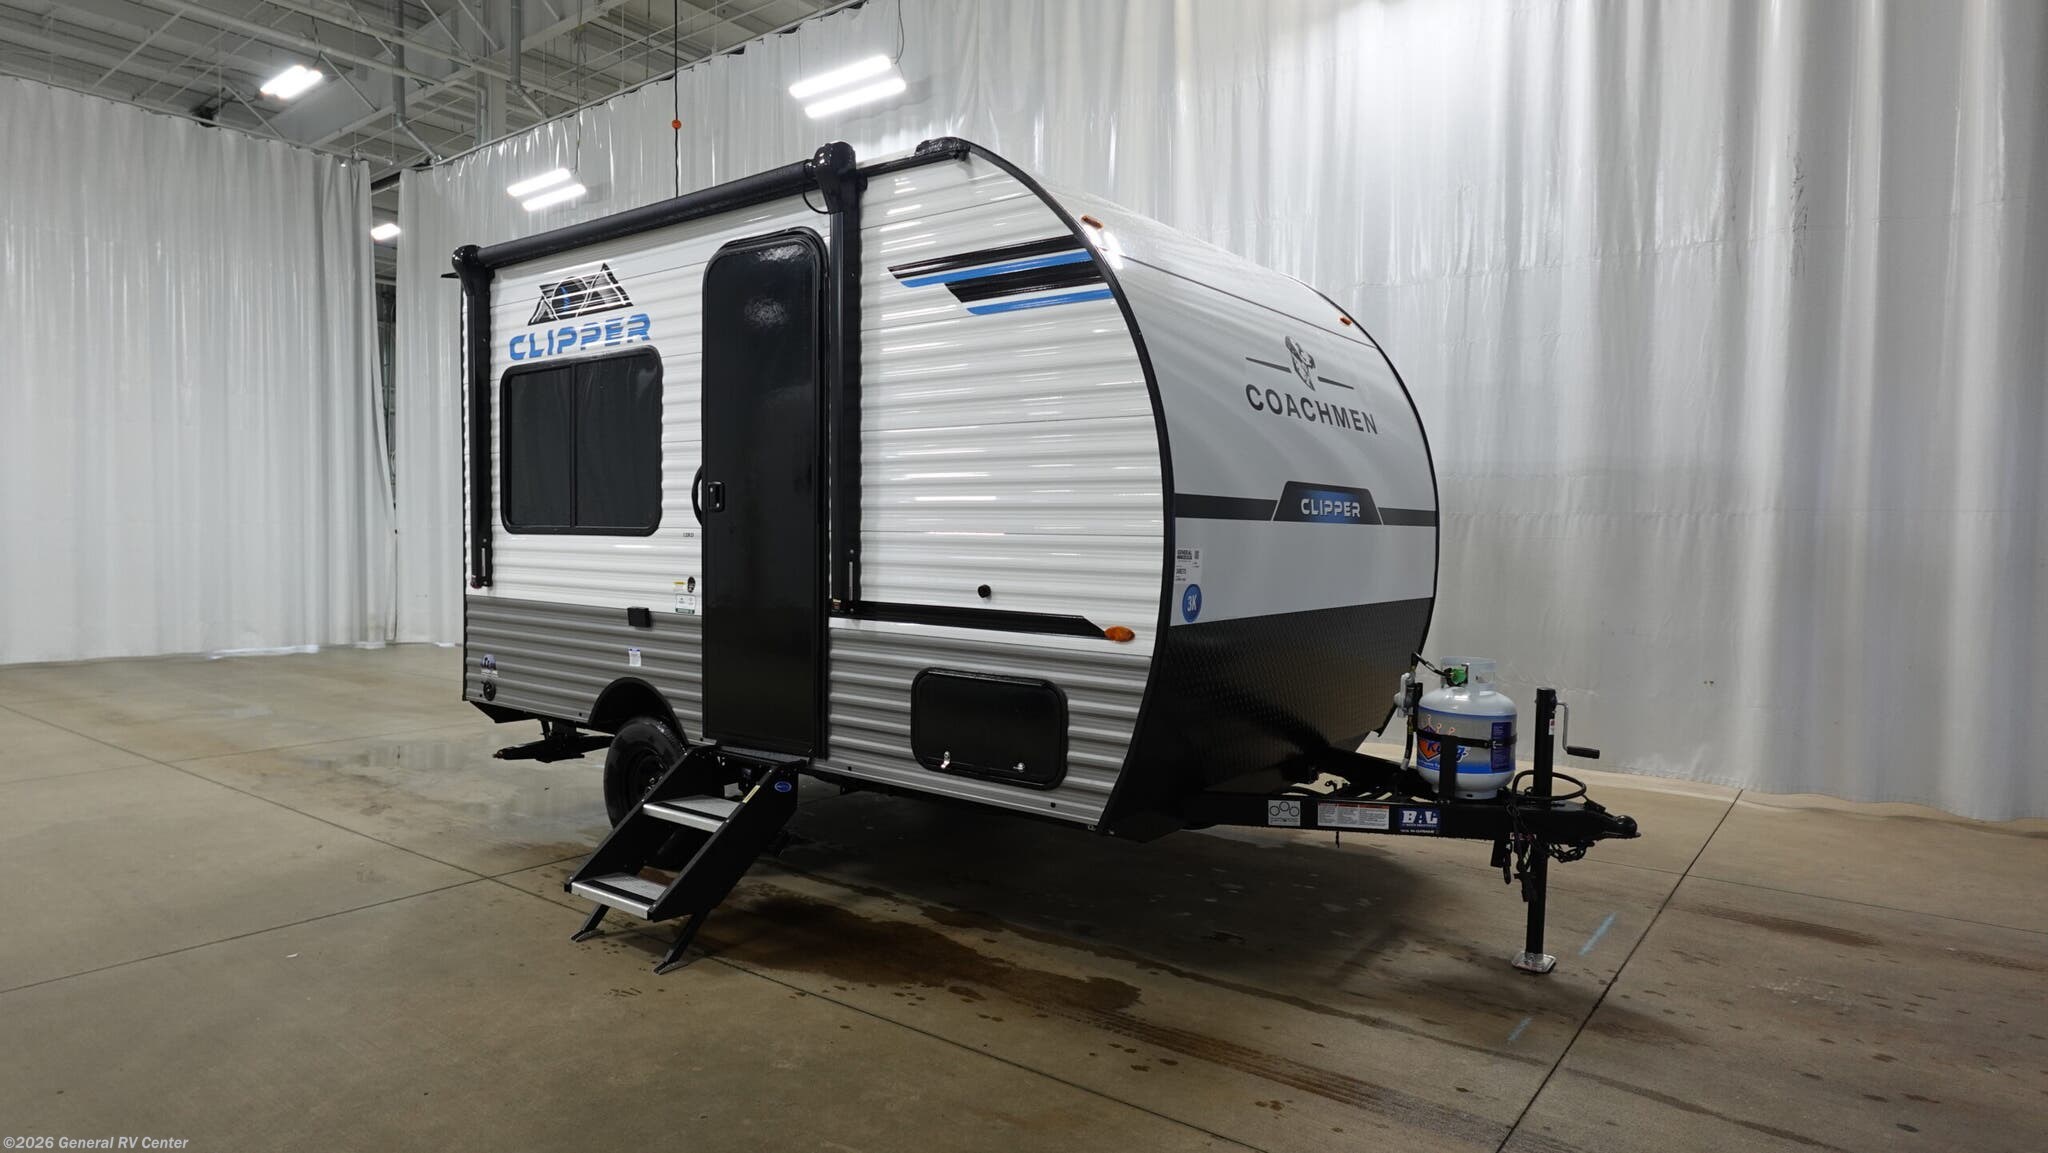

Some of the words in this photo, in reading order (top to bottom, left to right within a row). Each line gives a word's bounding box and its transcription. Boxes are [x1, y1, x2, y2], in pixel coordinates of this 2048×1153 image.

[509, 313, 652, 361] CLIPPER
[1245, 384, 1379, 435] COACHMEN
[1301, 498, 1361, 518] CLIPPER
[1402, 810, 1439, 824] BAL
